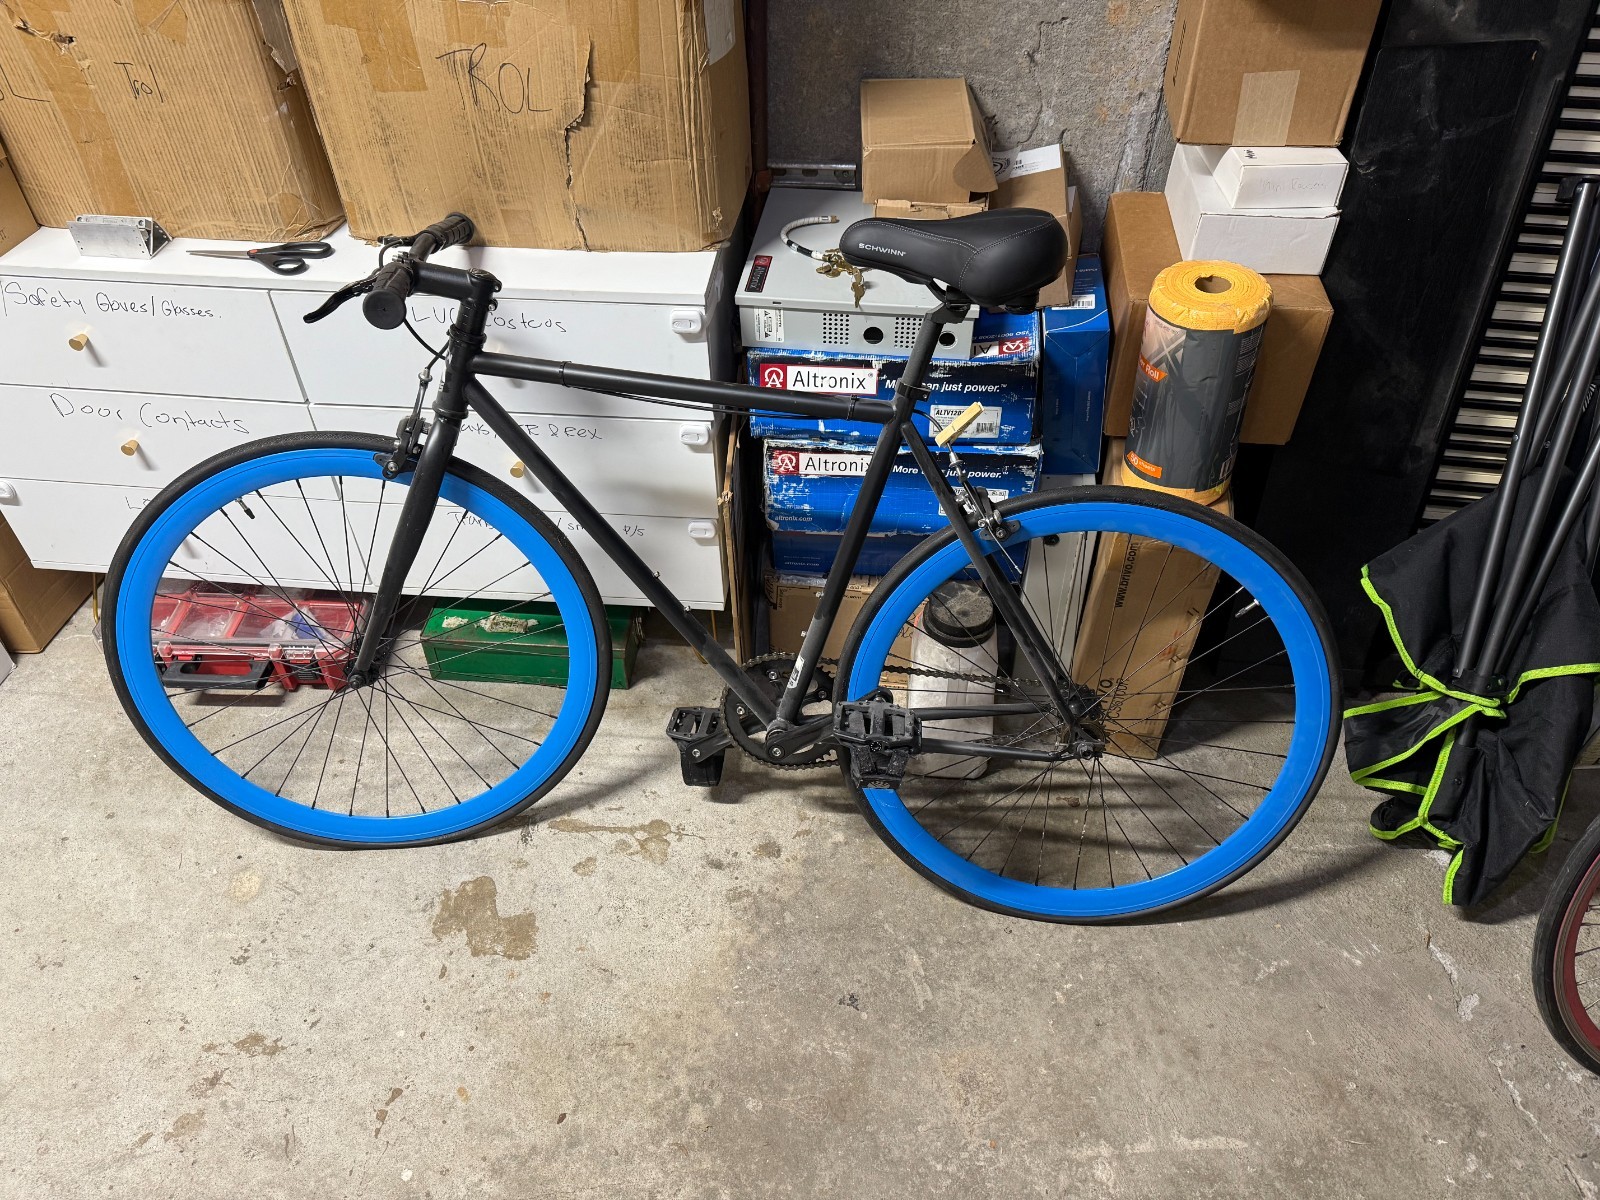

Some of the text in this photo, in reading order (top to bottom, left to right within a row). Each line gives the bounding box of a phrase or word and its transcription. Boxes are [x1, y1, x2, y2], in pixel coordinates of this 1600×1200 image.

[435, 42, 552, 114] TROL
[858, 242, 904, 257] SCHWINN
[792, 370, 866, 390] Altronix
[1145, 363, 1160, 380] Roll
[941, 382, 962, 393] just
[50, 393, 250, 434] Door Contacts
[892, 465, 919, 474] More
[1114, 542, 1140, 609] www.brivo.com
